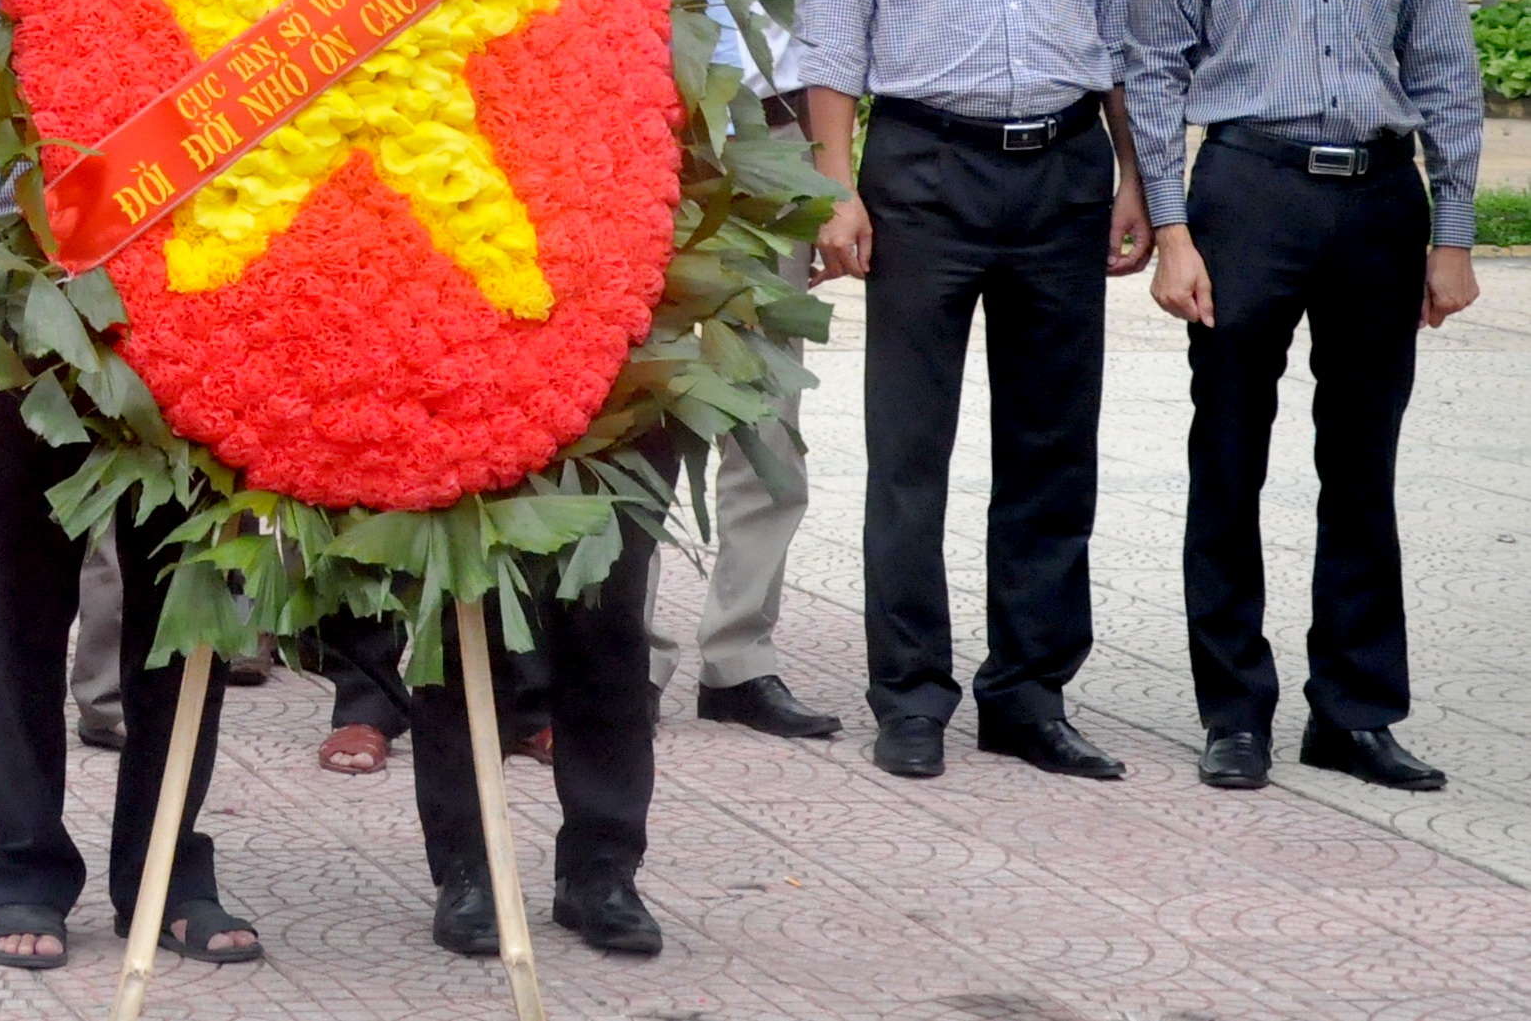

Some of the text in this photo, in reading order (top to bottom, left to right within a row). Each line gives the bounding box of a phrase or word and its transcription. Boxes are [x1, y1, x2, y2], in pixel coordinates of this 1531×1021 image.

[226, 42, 278, 83] TẦN
[277, 2, 311, 48] SỐ
[112, 161, 176, 225] ĐỜI
[180, 111, 243, 172] ĐỜI
[238, 51, 309, 126] NHỚ
[309, 24, 357, 76] ƠN
